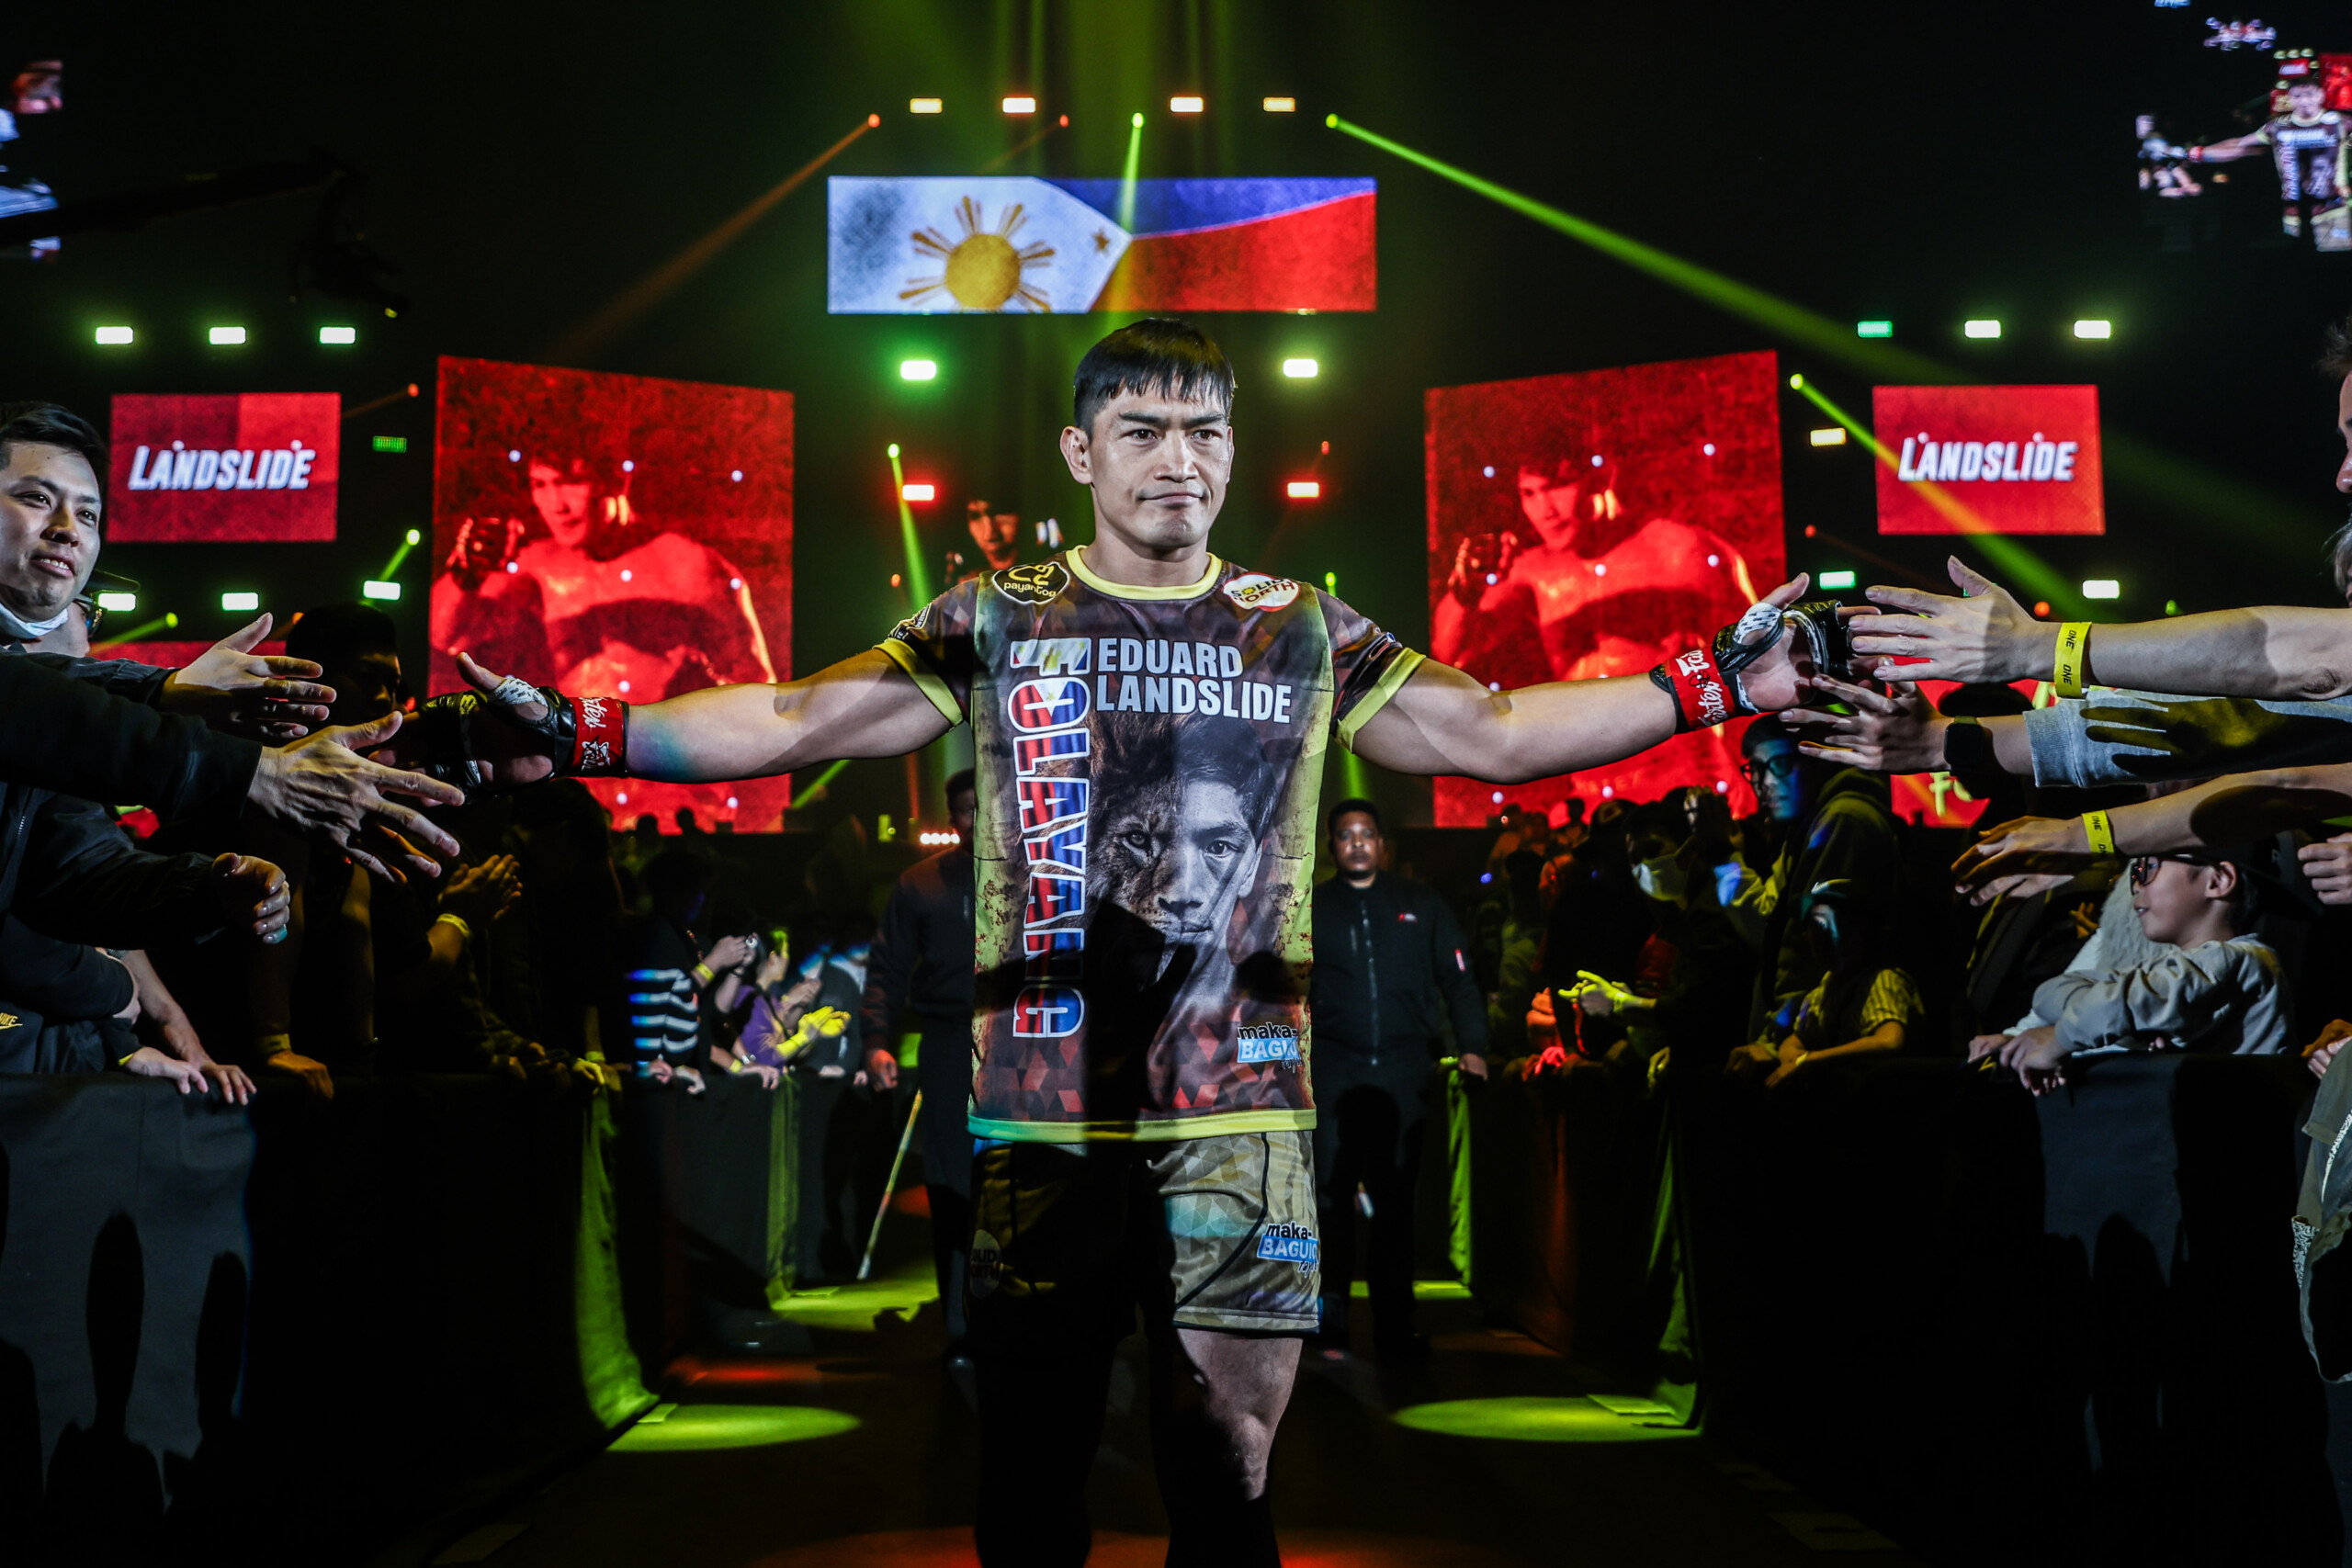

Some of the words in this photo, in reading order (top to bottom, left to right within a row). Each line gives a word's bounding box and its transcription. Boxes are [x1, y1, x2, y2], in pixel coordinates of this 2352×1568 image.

[128, 446, 316, 491] LANDSLIDE
[1898, 437, 2079, 481] LANDSLIDE
[1097, 637, 1244, 679] EDUARD
[2065, 629, 2077, 649] ONE
[2062, 663, 2073, 685] ONE
[1096, 674, 1292, 724] LANDSLIDE
[1007, 637, 1091, 1038] FOLAYANG
[1238, 1021, 1297, 1040] maka-
[1265, 1222, 1313, 1240] maka-
